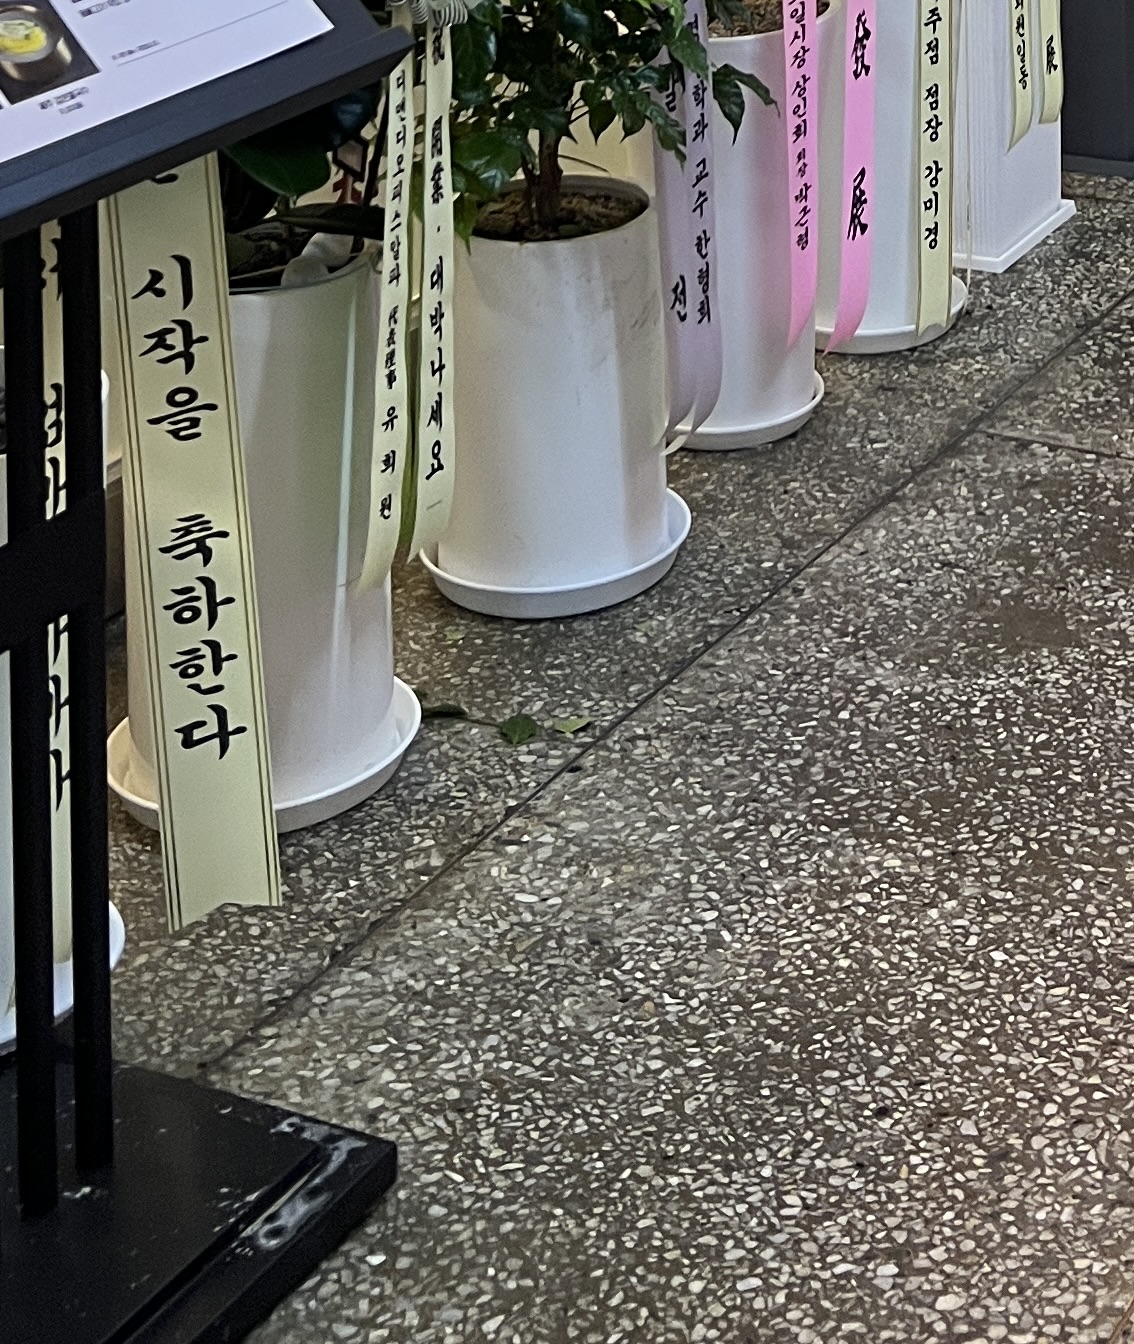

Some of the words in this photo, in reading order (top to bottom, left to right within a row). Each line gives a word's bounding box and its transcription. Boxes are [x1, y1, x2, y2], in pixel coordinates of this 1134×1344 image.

[791, 72, 812, 144] 상인회
[922, 83, 943, 143] 점장
[691, 157, 709, 219] 교수
[795, 147, 809, 179] 회장
[922, 159, 943, 250] 강미경
[130, 253, 219, 443] 시작을
[425, 254, 446, 481] 대박나세요
[157, 512, 249, 761] 축하한다
